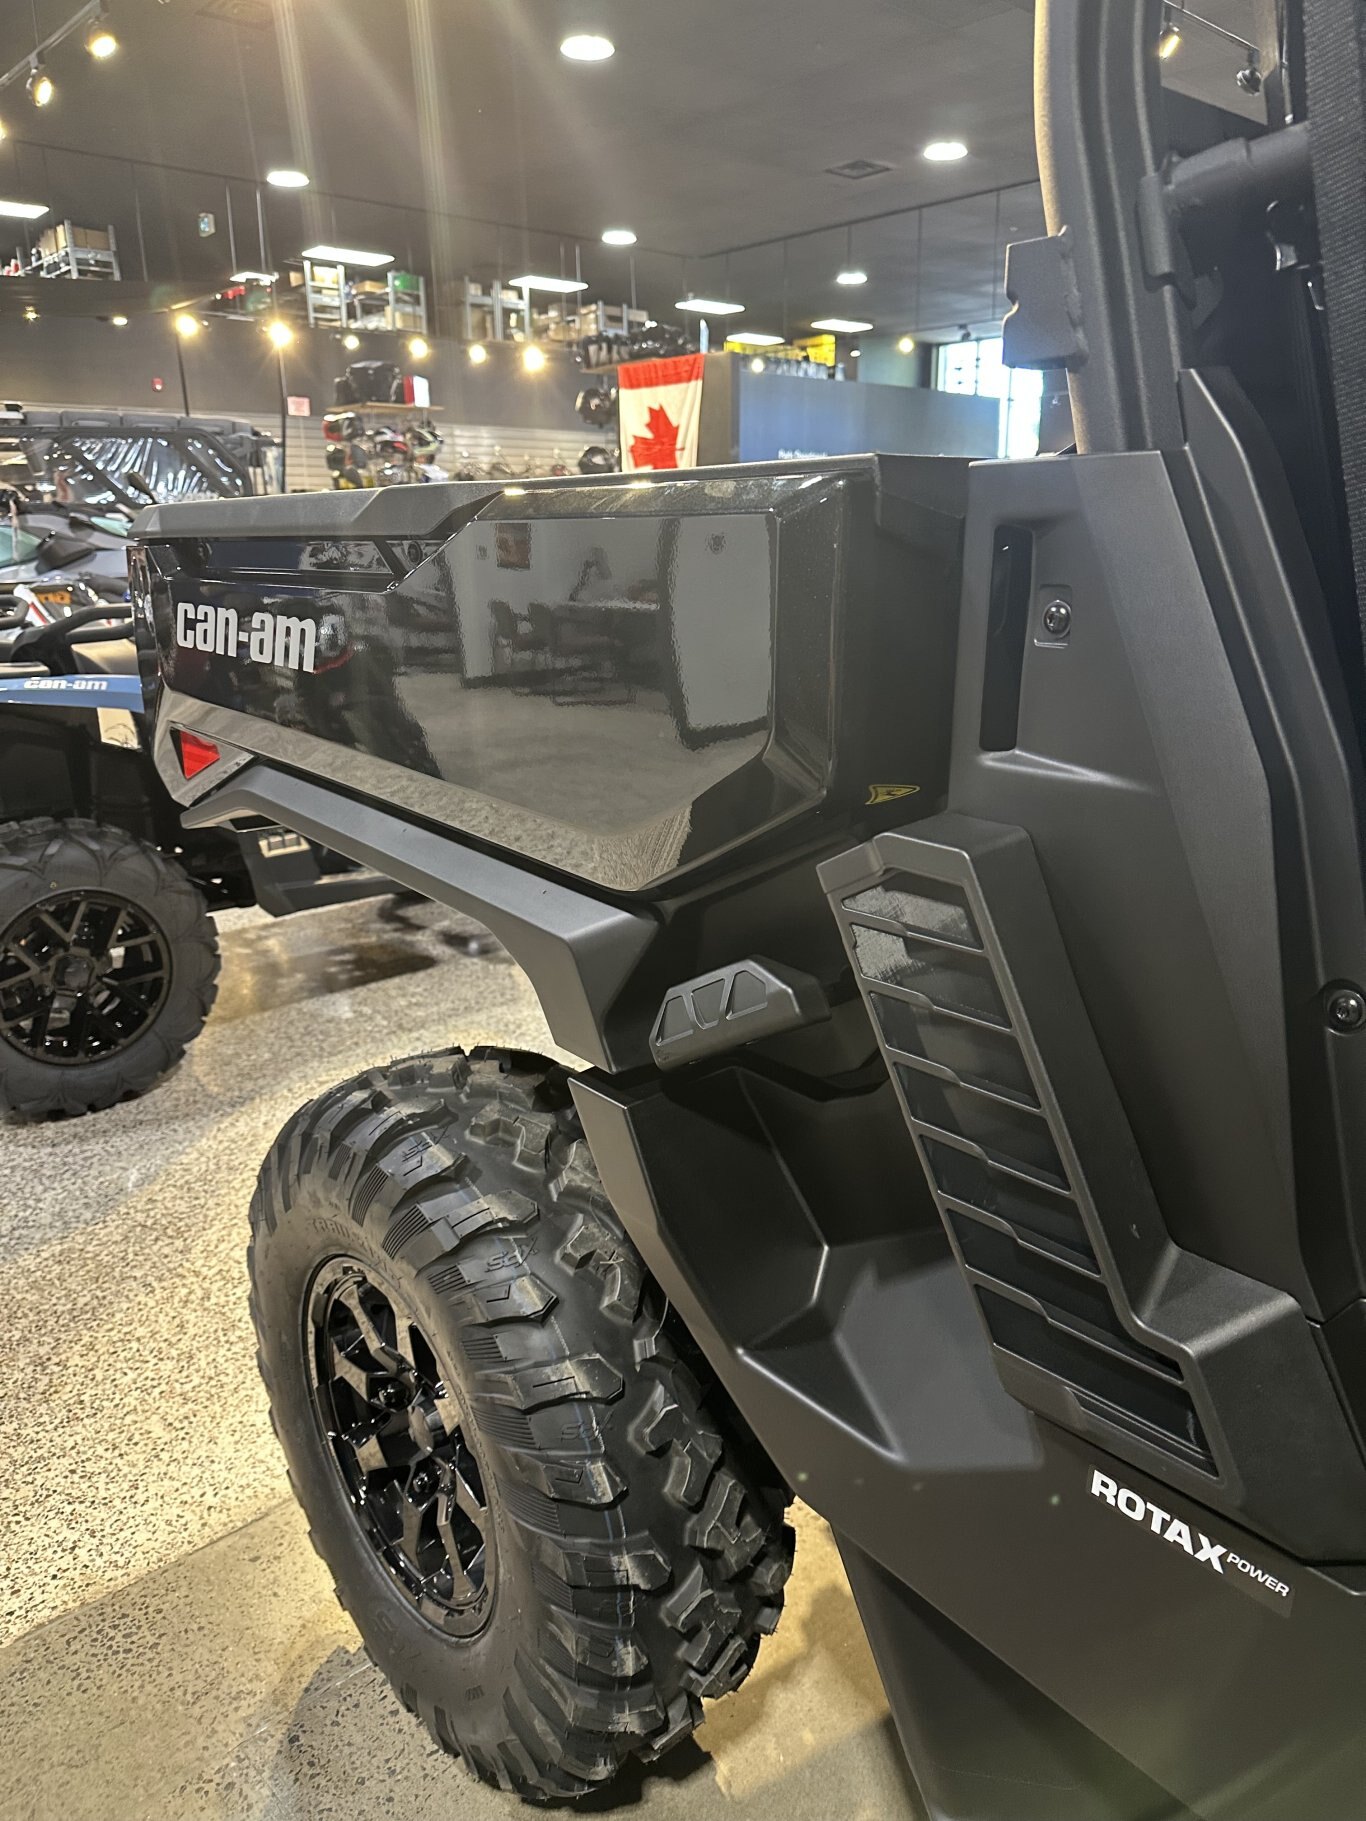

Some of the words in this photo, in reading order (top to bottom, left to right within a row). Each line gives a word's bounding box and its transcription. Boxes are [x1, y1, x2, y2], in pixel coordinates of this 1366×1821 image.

[176, 602, 317, 674] can-am
[23, 679, 108, 691] can-am
[1091, 1469, 1228, 1575] ROTAX
[1226, 1552, 1290, 1597] POWER
